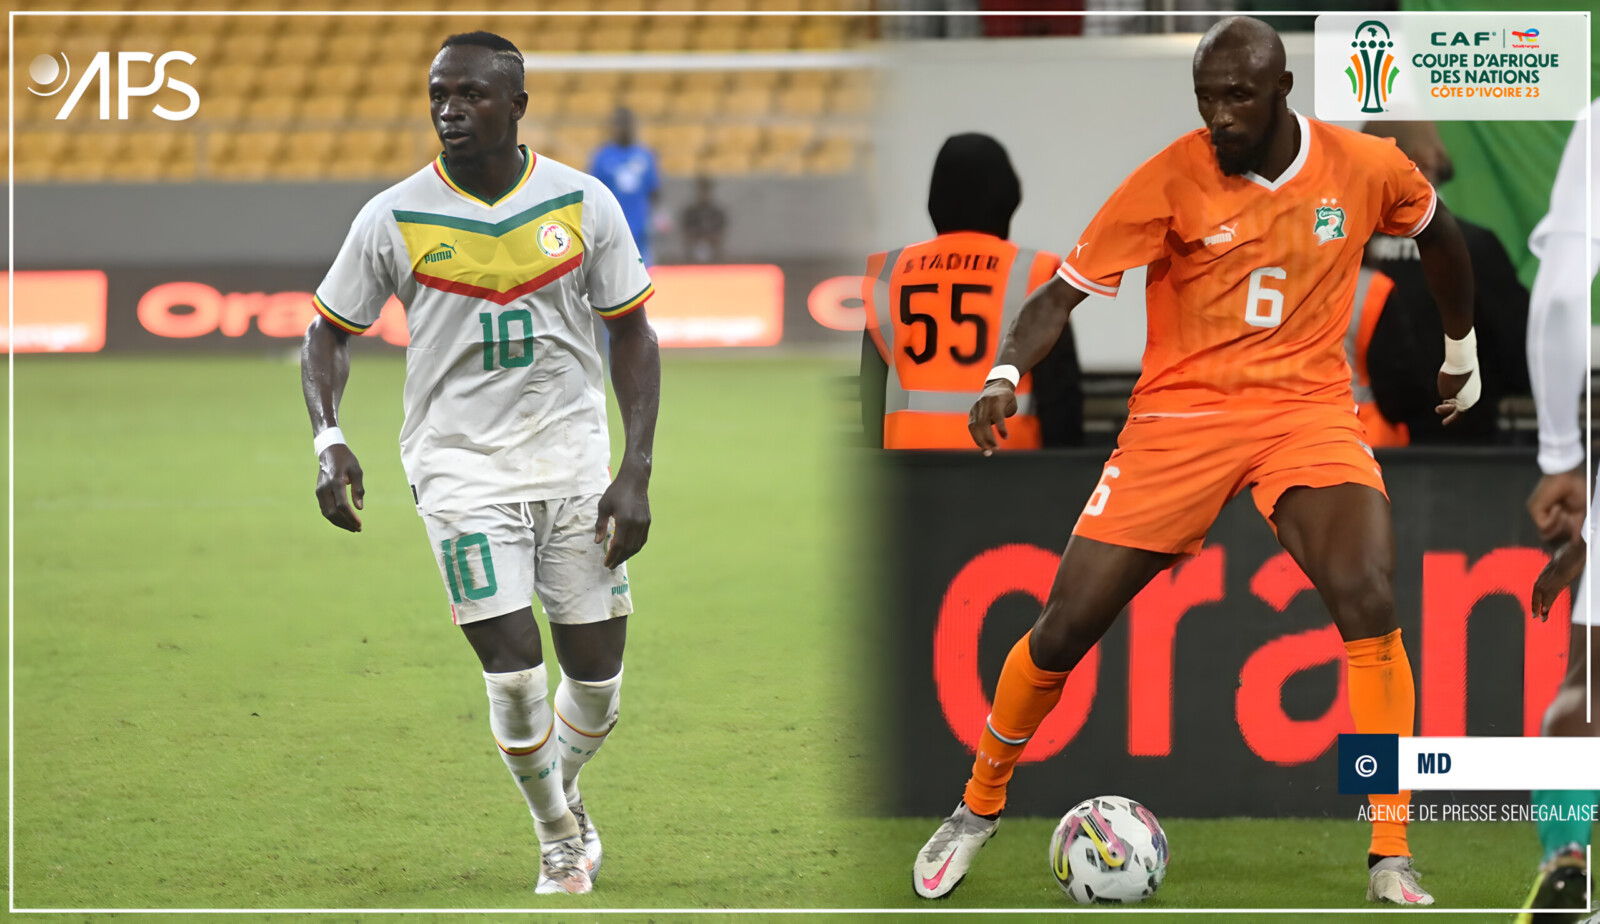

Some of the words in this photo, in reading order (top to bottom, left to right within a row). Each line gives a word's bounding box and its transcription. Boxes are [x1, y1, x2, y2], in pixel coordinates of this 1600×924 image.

[424, 250, 452, 264] PUMA
[1204, 232, 1233, 247] PUMA
[900, 283, 993, 366] 55
[1245, 267, 1287, 328] 6
[479, 309, 534, 371] 10
[1083, 465, 1120, 517] 6
[441, 532, 498, 604] 10
